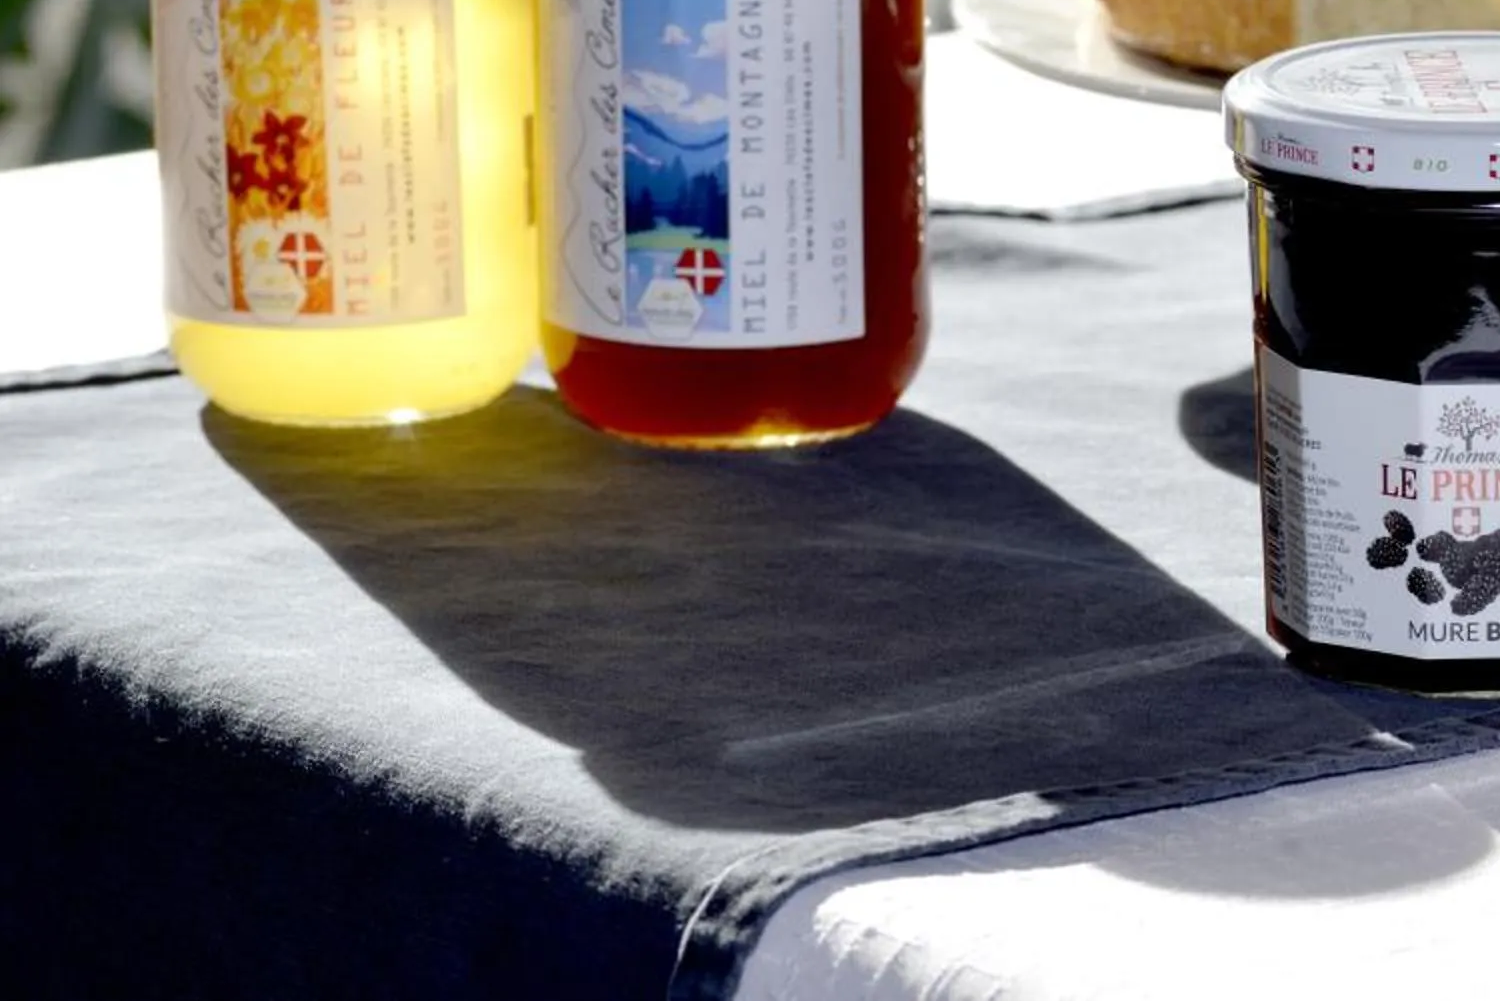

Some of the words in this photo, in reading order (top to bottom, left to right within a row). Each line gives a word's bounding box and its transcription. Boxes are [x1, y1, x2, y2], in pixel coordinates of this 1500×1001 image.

[194, 69, 219, 120] des
[590, 83, 618, 134] des
[338, 144, 364, 187] DE
[1260, 138, 1275, 155] LE
[1276, 140, 1319, 166] PRINCE
[1413, 158, 1449, 172] BIO
[740, 181, 766, 220] DE
[343, 221, 369, 316] MIEL
[742, 250, 768, 335] MIEL
[1381, 463, 1418, 499] LE
[1408, 620, 1482, 642] MURE
